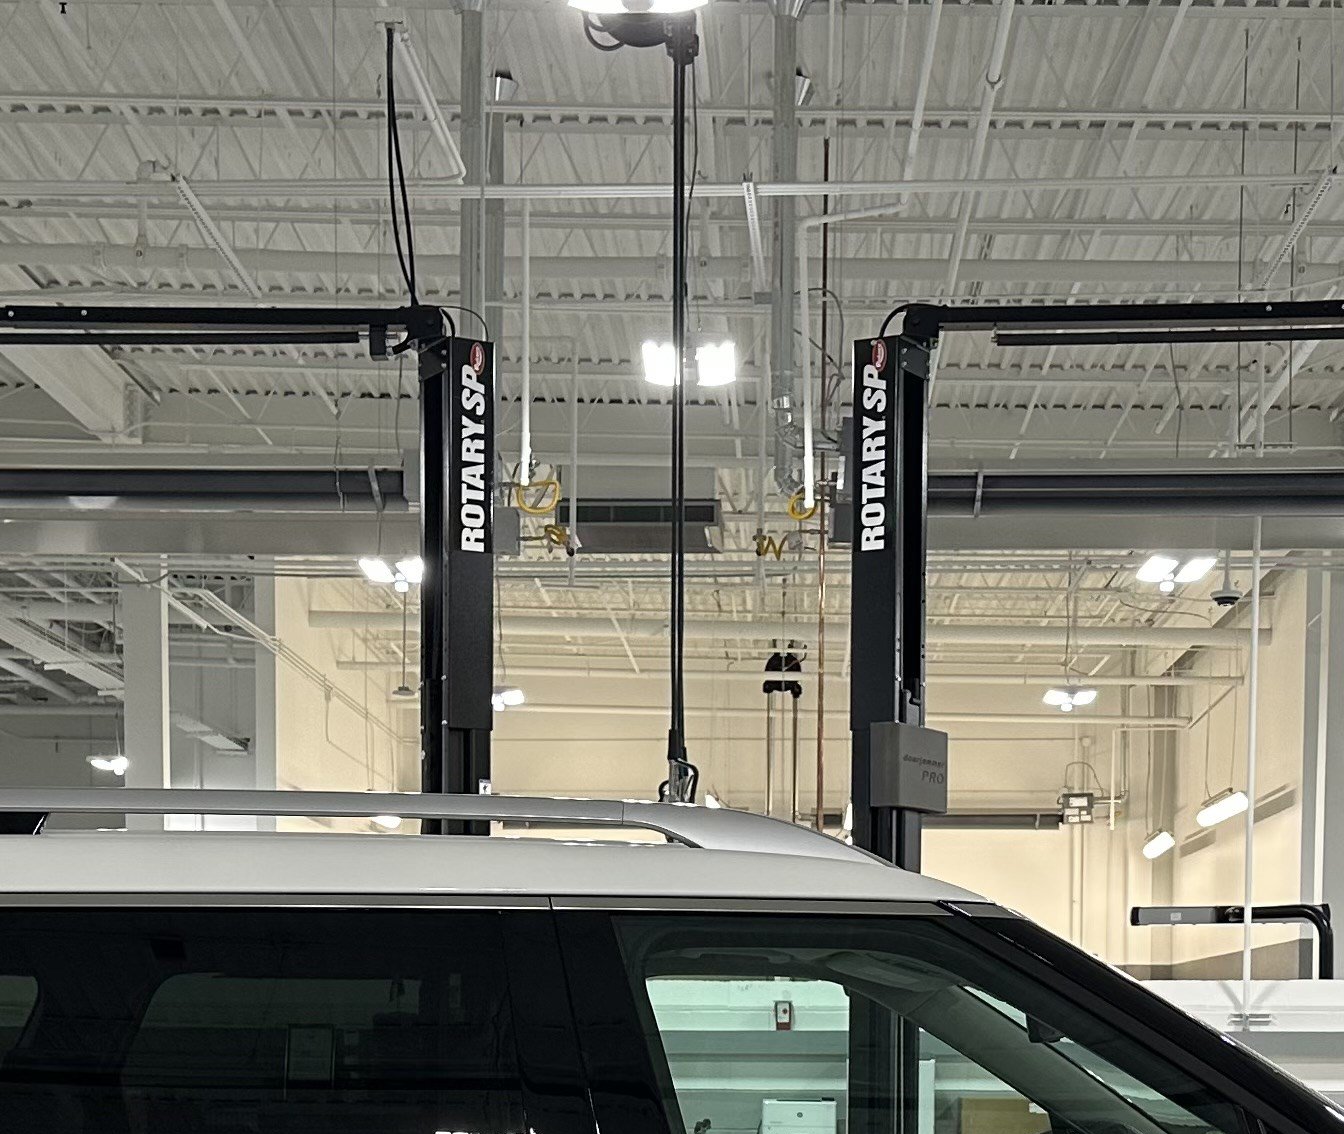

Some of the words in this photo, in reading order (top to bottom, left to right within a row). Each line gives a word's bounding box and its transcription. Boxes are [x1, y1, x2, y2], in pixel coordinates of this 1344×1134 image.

[461, 364, 486, 416] SP
[862, 364, 887, 413] SP
[460, 415, 485, 552] ROTARY
[860, 416, 887, 551] ROTARY
[921, 770, 945, 784] PRO
